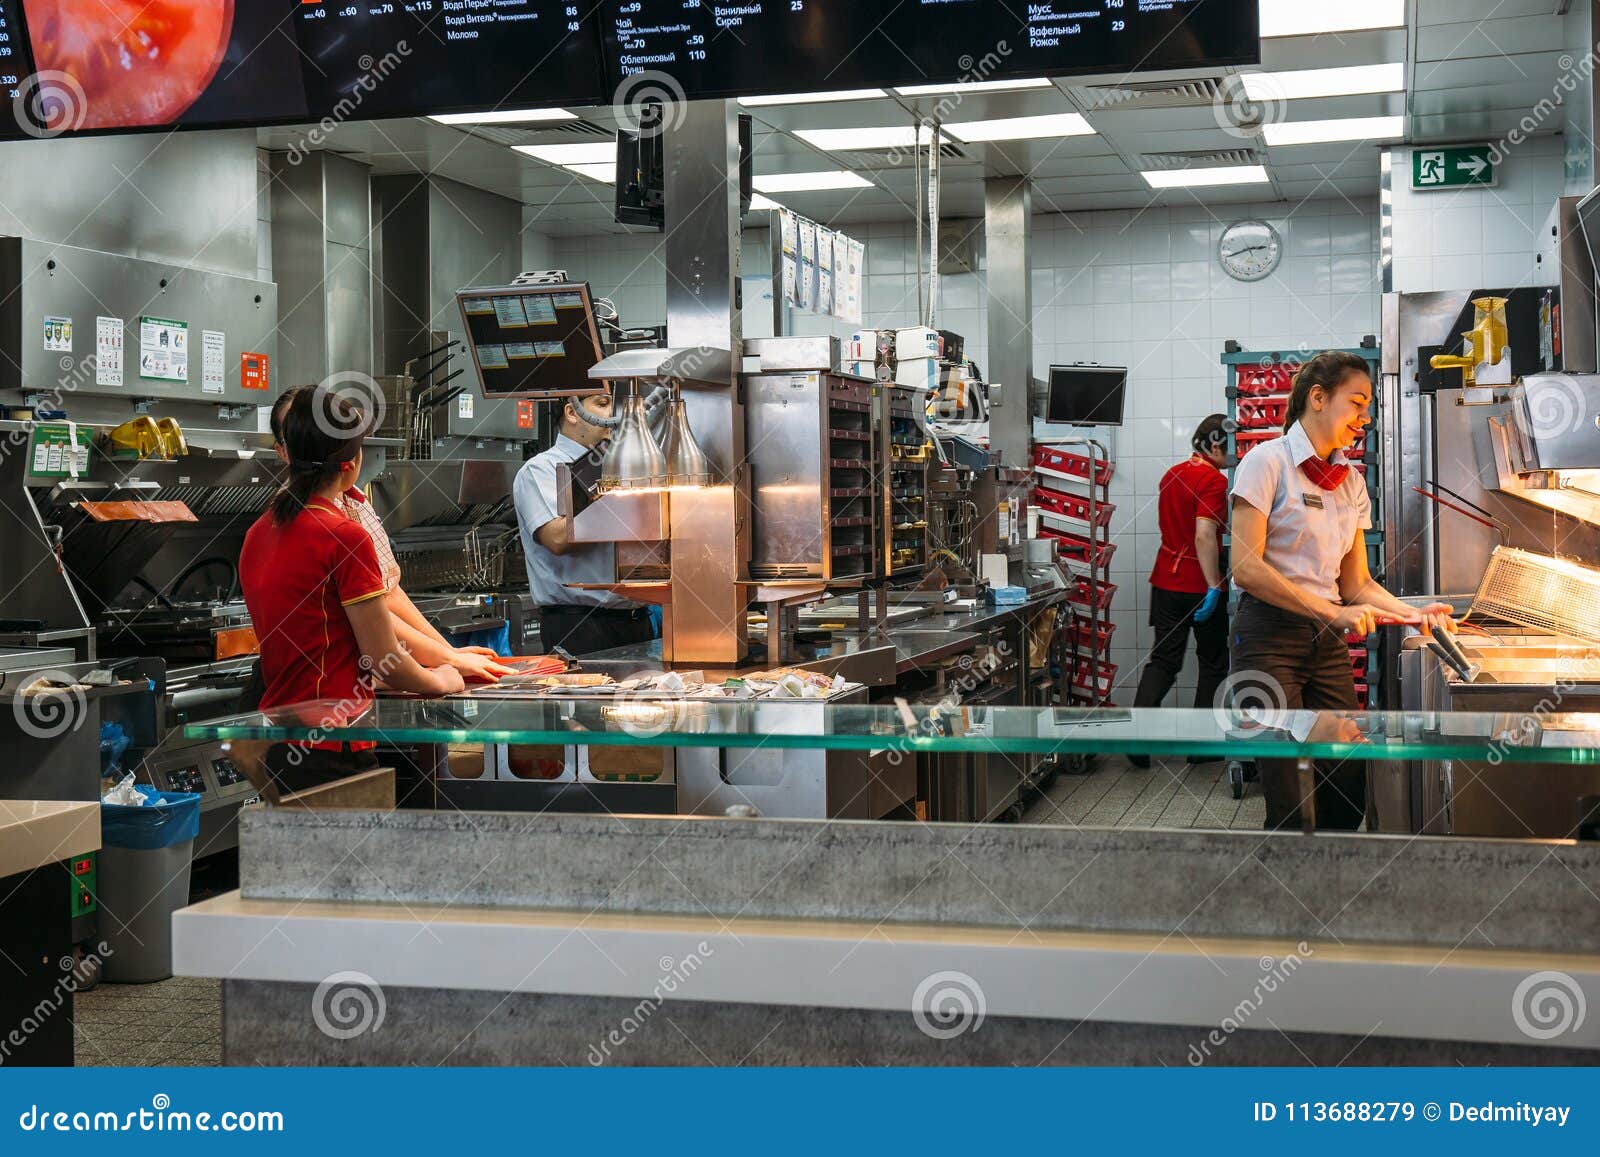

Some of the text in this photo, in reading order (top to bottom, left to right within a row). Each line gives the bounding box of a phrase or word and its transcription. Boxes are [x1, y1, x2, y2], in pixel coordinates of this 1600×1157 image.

[444, 1, 463, 10] Вода
[791, 1, 803, 11] 25
[1105, 0, 1124, 8] 140
[566, 7, 577, 16] 86
[714, 3, 762, 16] Ванильный
[1028, 4, 1052, 16] Мусс
[445, 16, 465, 25] Вода
[616, 19, 632, 28] Чай
[715, 17, 742, 28] Сироп
[567, 22, 579, 31] 48
[1029, 24, 1080, 37] Вафельный
[1112, 21, 1125, 31] 29
[447, 30, 479, 40] Молоко
[1030, 38, 1059, 48] Рожок
[620, 52, 676, 64] Облепиховый
[689, 50, 706, 60] 110
[621, 66, 645, 76] Пунш
[10, 89, 20, 97] 20
